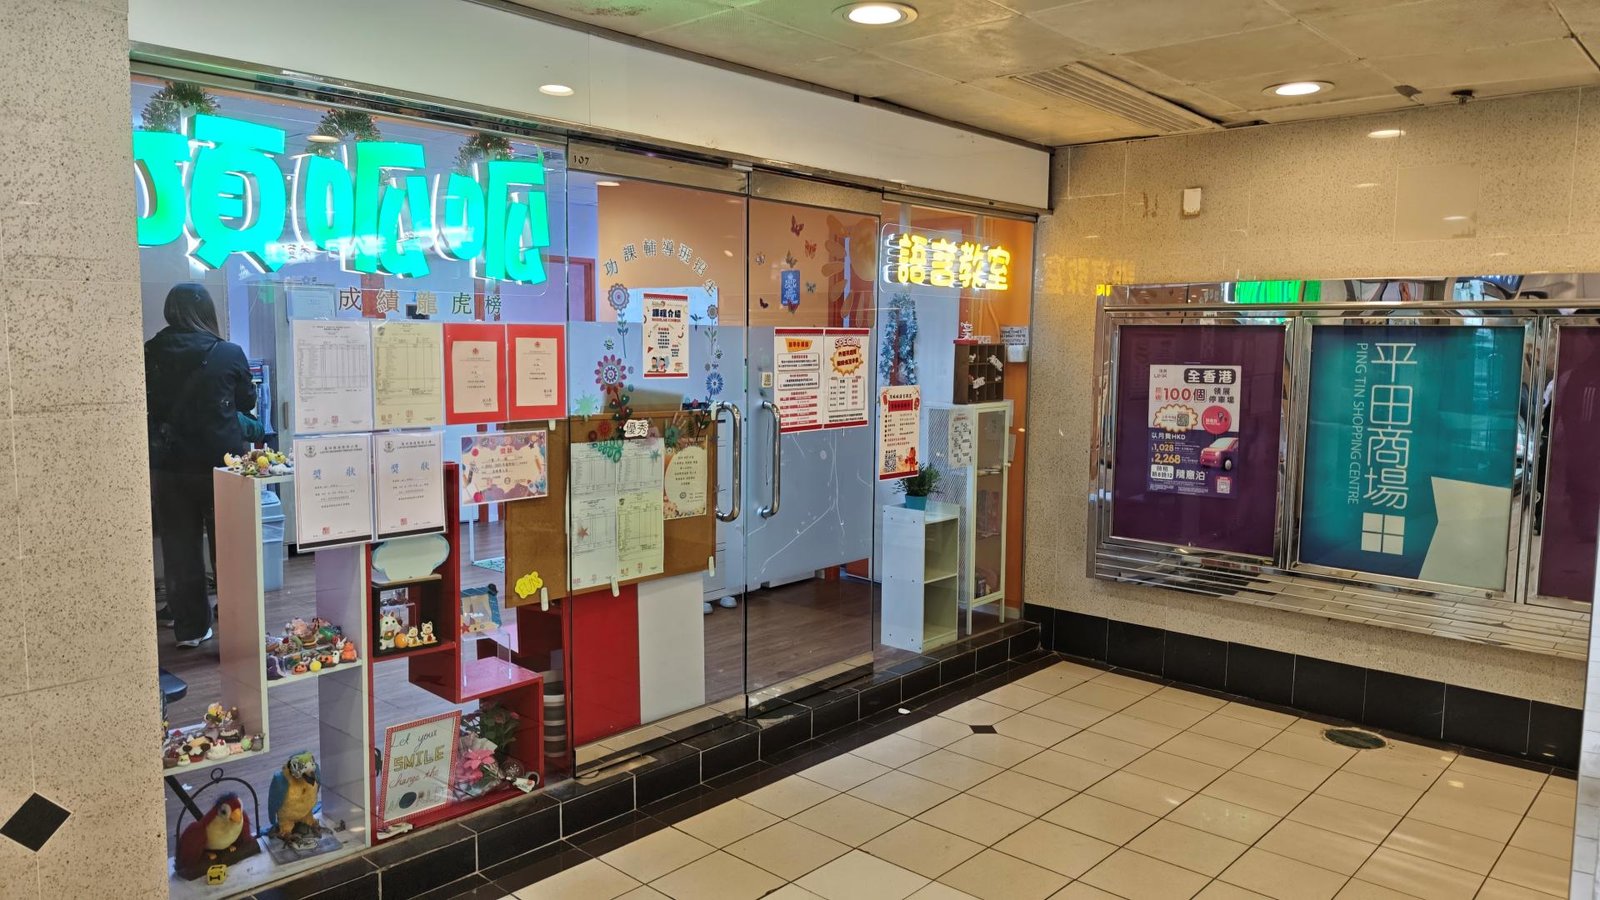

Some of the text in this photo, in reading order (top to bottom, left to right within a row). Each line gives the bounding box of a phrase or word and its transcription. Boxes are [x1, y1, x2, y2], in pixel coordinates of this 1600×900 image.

[573, 155, 590, 165] 107
[603, 239, 718, 298] 功課輔導班招生
[897, 233, 1011, 291] 語言教室
[338, 287, 502, 315] 成績龍虎榜
[1188, 369, 1233, 384] 全香港
[1163, 387, 1206, 402] 100個
[1208, 395, 1235, 404] 停車場
[625, 421, 648, 436] 優秀
[1347, 344, 1368, 505] PING TIN SHOPPING CENTRE
[1363, 343, 1418, 510] 平田商場
[1175, 469, 1206, 480] 隨意泊
[390, 729, 438, 753] Let your
[393, 745, 445, 772] SMILE
